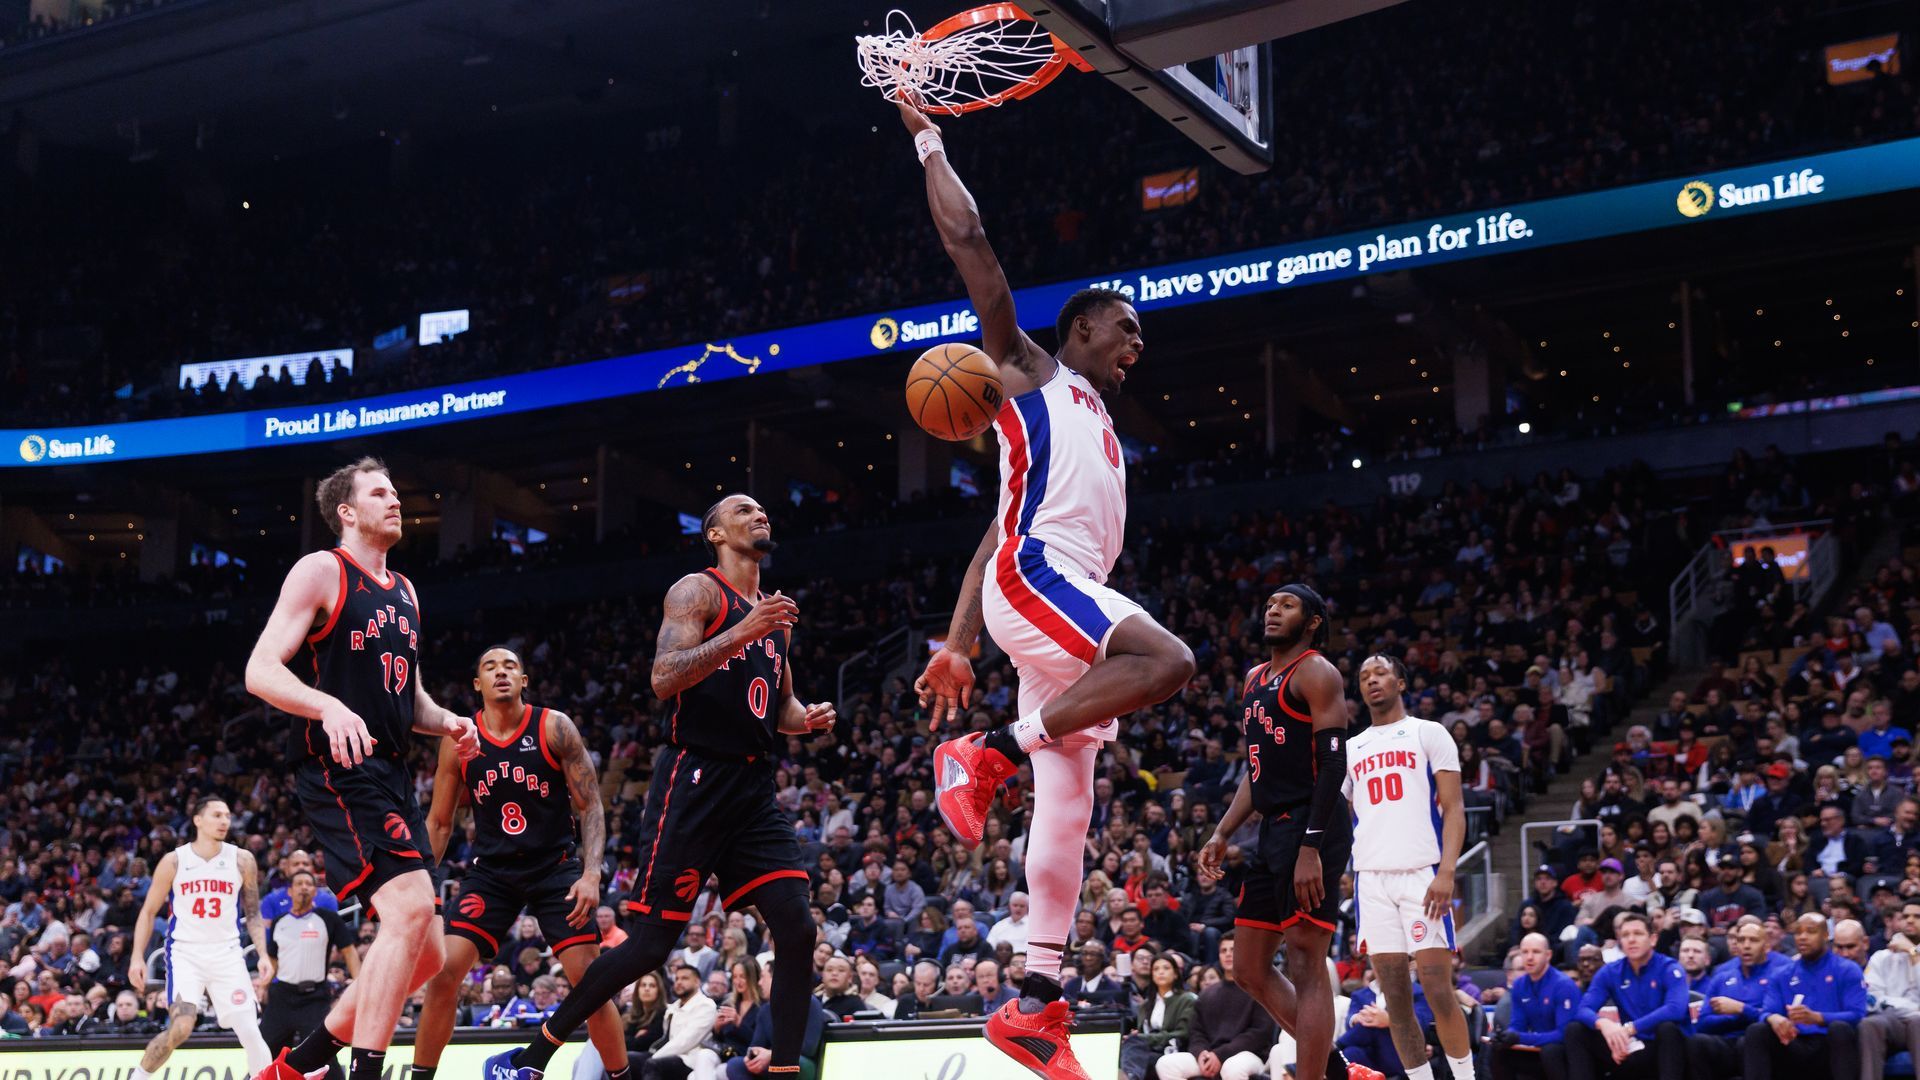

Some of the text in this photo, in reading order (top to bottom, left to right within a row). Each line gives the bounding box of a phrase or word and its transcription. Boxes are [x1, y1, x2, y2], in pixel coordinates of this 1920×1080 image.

[1718, 168, 1825, 209] Sun Life
[1139, 275, 1203, 302] have
[1208, 260, 1272, 296] your
[1277, 247, 1352, 284] game
[1357, 234, 1423, 271] plan
[1427, 223, 1472, 254] for
[1476, 211, 1534, 245] life.
[900, 309, 979, 342] Sun Life
[264, 390, 507, 438] Proud Life Insurance Partner
[48, 434, 116, 459] Sun Life
[1102, 428, 1119, 469] 0
[1388, 473, 1421, 494] 119
[351, 604, 418, 651] RAPTOR
[380, 652, 409, 695] 19
[748, 676, 769, 719] 0
[1243, 700, 1286, 745] PTORS
[1249, 744, 1261, 783] 5
[1353, 750, 1417, 782] PISTONS
[1367, 772, 1403, 806] 00
[501, 802, 527, 835] 8
[180, 880, 234, 896] PISTONS
[192, 897, 222, 919] 43
